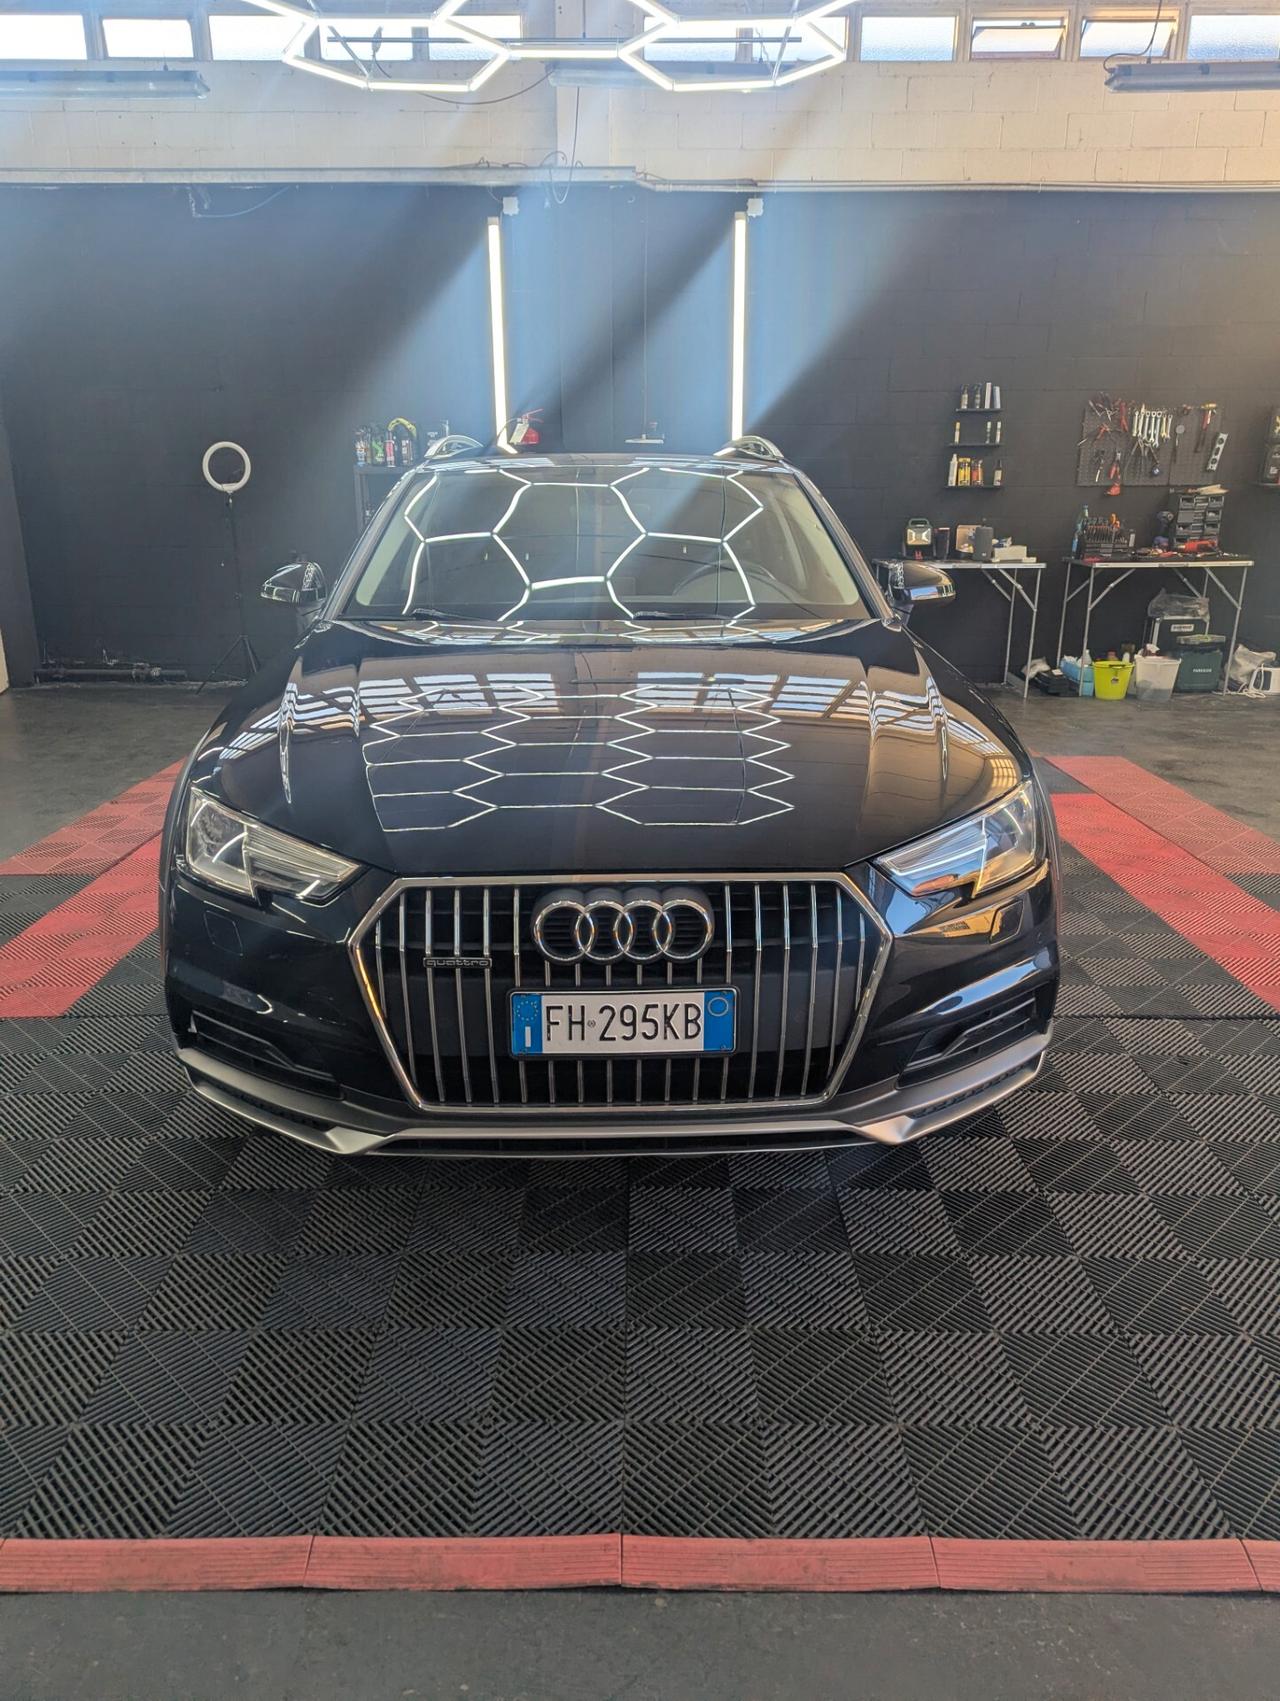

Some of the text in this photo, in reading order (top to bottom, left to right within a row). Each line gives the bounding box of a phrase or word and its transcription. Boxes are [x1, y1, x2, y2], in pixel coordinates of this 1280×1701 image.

[426, 959, 489, 968] quattro
[545, 1003, 702, 1042] FH 295KB
